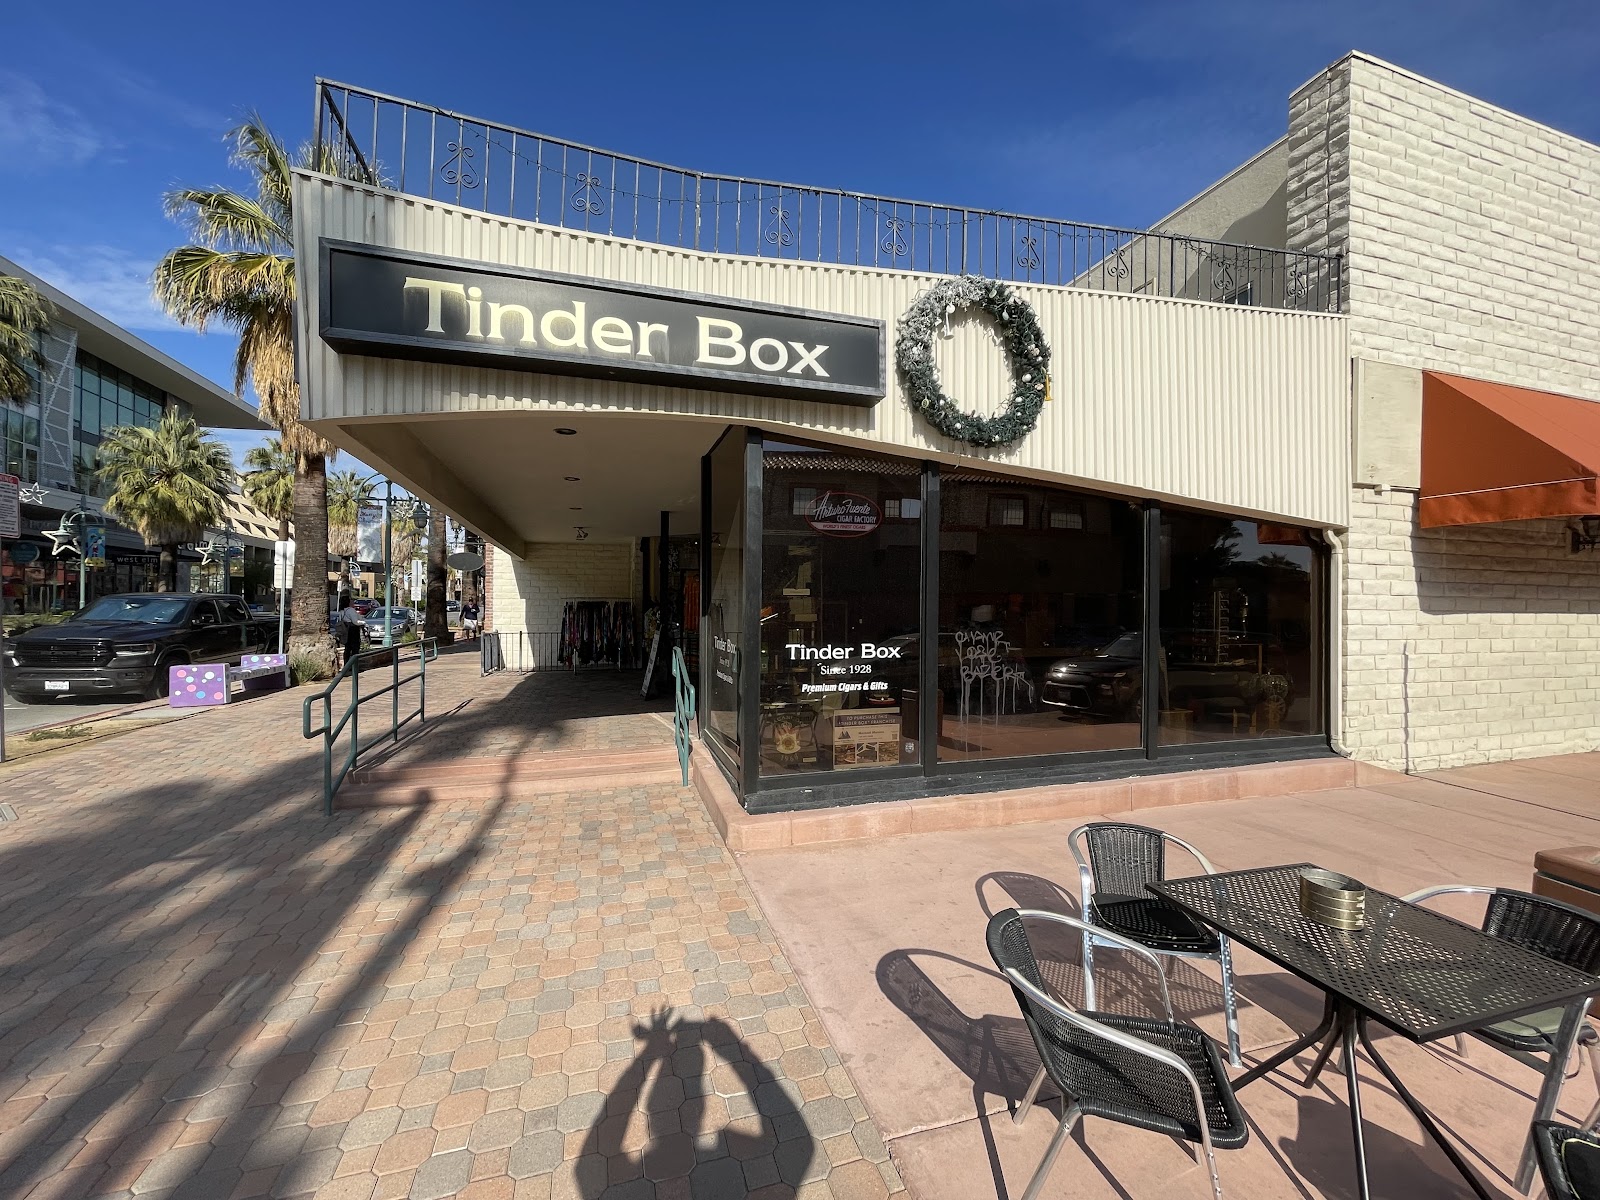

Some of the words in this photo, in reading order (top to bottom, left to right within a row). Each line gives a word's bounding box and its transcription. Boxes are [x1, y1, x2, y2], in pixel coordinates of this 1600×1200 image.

[403, 276, 670, 358] Tinder
[695, 316, 830, 378] Box
[813, 492, 846, 520] Arturo
[843, 499, 871, 514] Fuente
[836, 515, 853, 523] CIGAR
[854, 516, 877, 524] FACTORY
[714, 635, 727, 651] Tinder
[785, 643, 854, 660] Tinder
[861, 643, 901, 659] Box
[820, 665, 846, 675] Since
[849, 665, 872, 674] 1928
[802, 683, 837, 693] Premium
[838, 682, 862, 693] Cigars
[863, 681, 869, 690] &
[870, 681, 888, 690] Gifts
